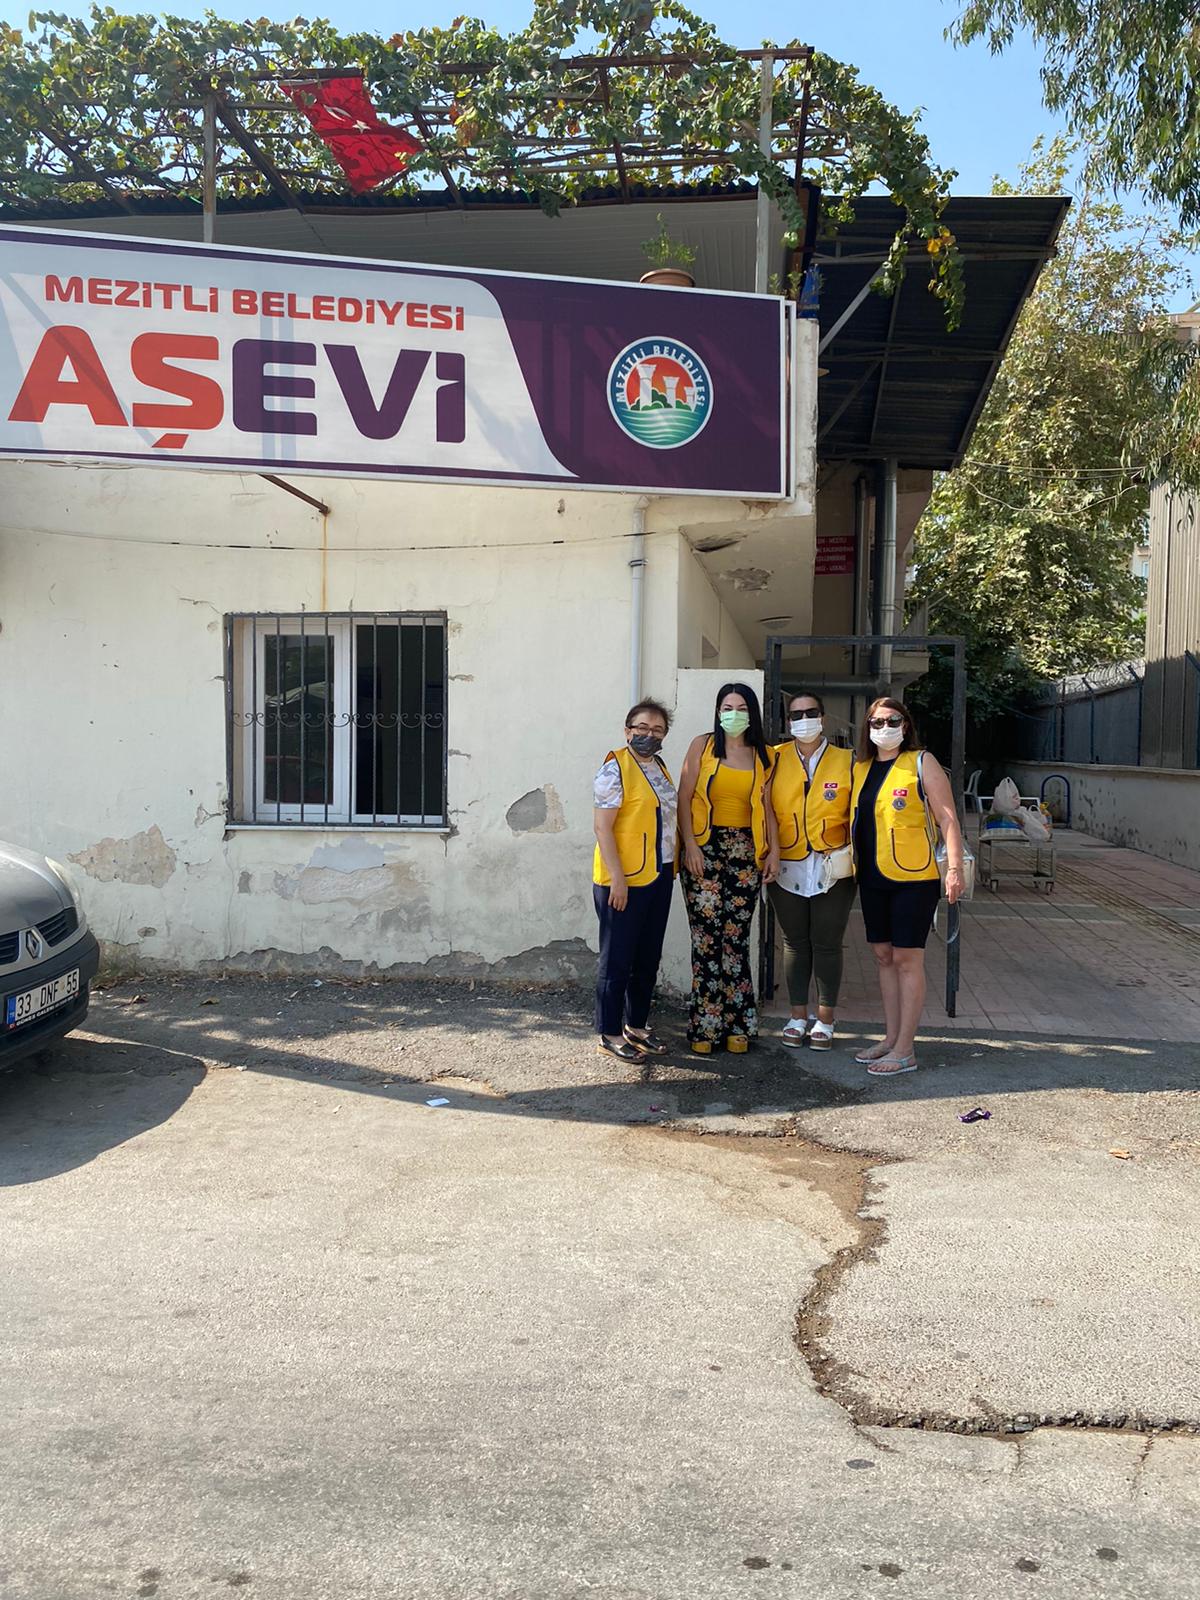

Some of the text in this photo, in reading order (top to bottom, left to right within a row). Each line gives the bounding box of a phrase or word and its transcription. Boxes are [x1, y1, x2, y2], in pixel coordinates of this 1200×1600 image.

[45, 274, 465, 331] MEZİTLİ BELEDİYESİ
[7, 325, 466, 450] AŞEVİ
[17, 993, 31, 1018] 33
[40, 981, 59, 1007] DNF
[67, 972, 77, 993] 55
